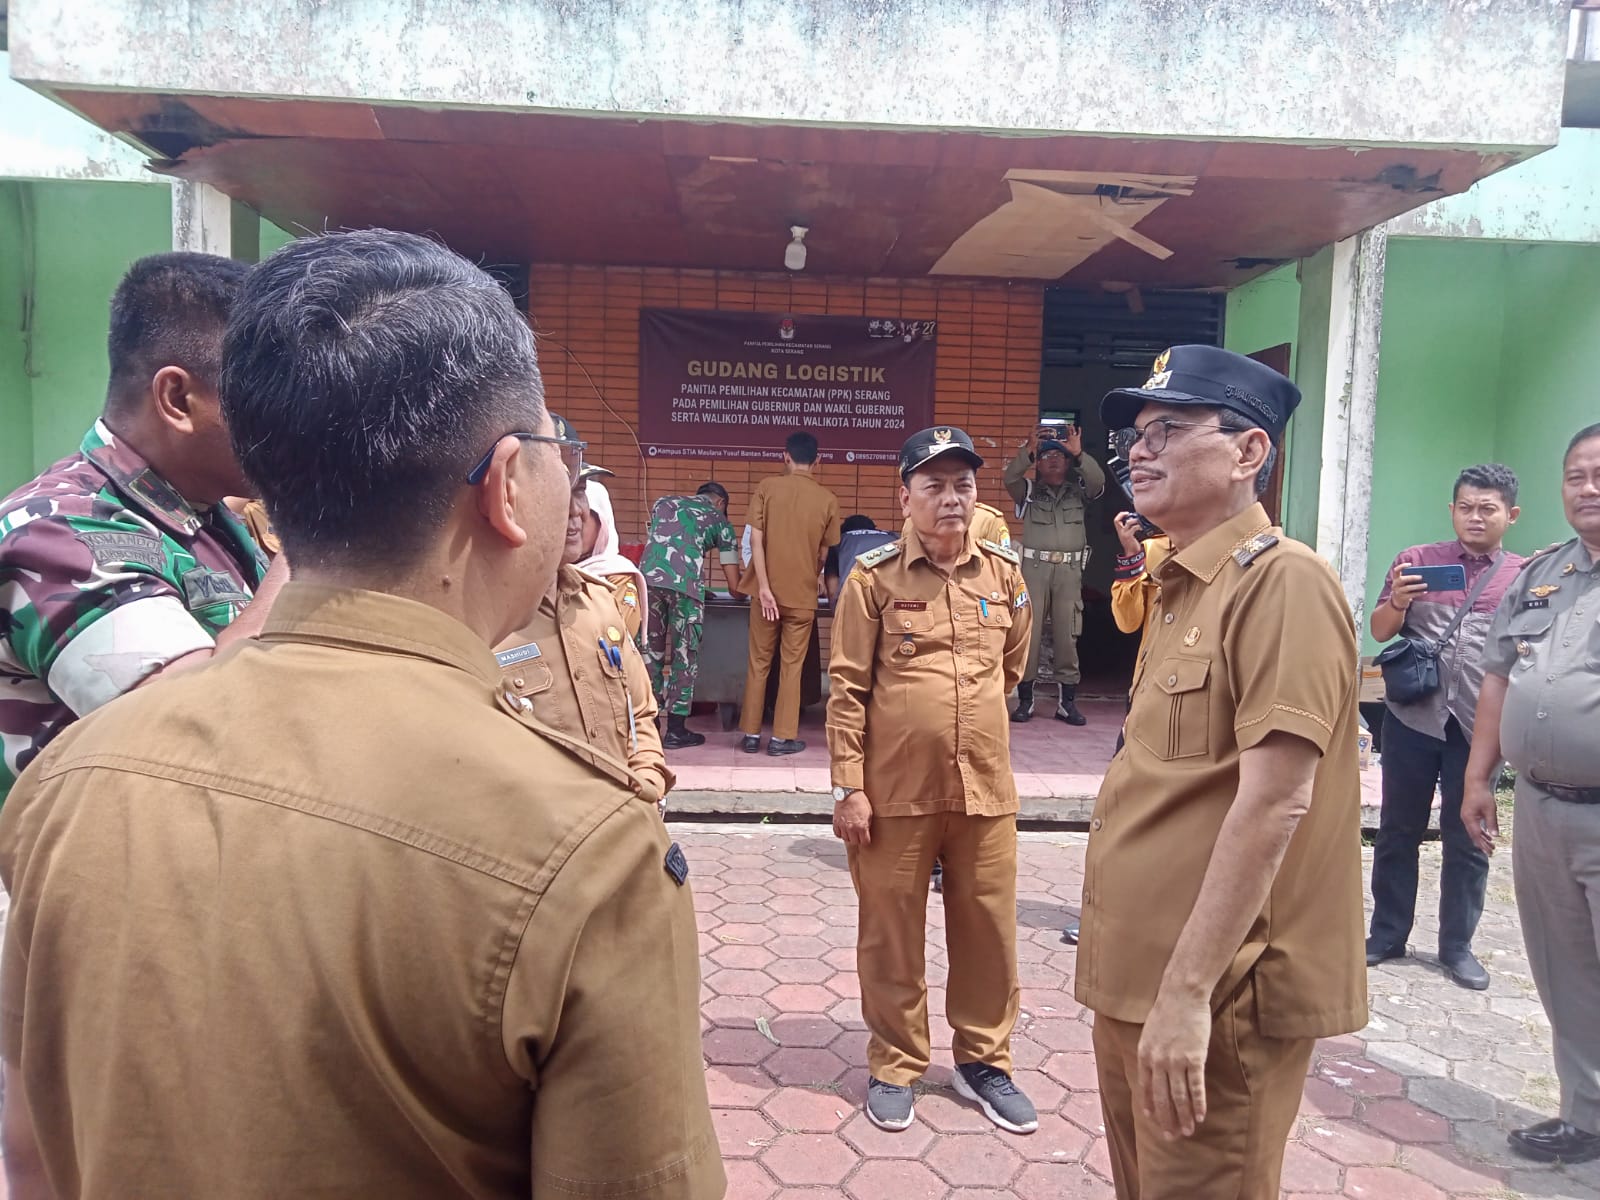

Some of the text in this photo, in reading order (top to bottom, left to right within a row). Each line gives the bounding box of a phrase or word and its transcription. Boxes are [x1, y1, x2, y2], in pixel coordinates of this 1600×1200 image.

[687, 359, 886, 385] GUDANG LOGISTIK
[681, 383, 890, 402] PANITIA PEMILIHAN KECAMATAN (PPK) SERANG
[673, 397, 905, 416] PADA PEMILIHAN GUBERNUR DAN WAKIL GUBERNUR
[671, 411, 905, 430] SERTA WALIKOTA DAN WAKIL WALIKOTA TAHUN 2024
[657, 447, 682, 456] Kampus
[682, 448, 697, 456] STIA
[697, 449, 722, 457] Maulana
[722, 449, 740, 457] Yusuf
[762, 451, 783, 459] Serang
